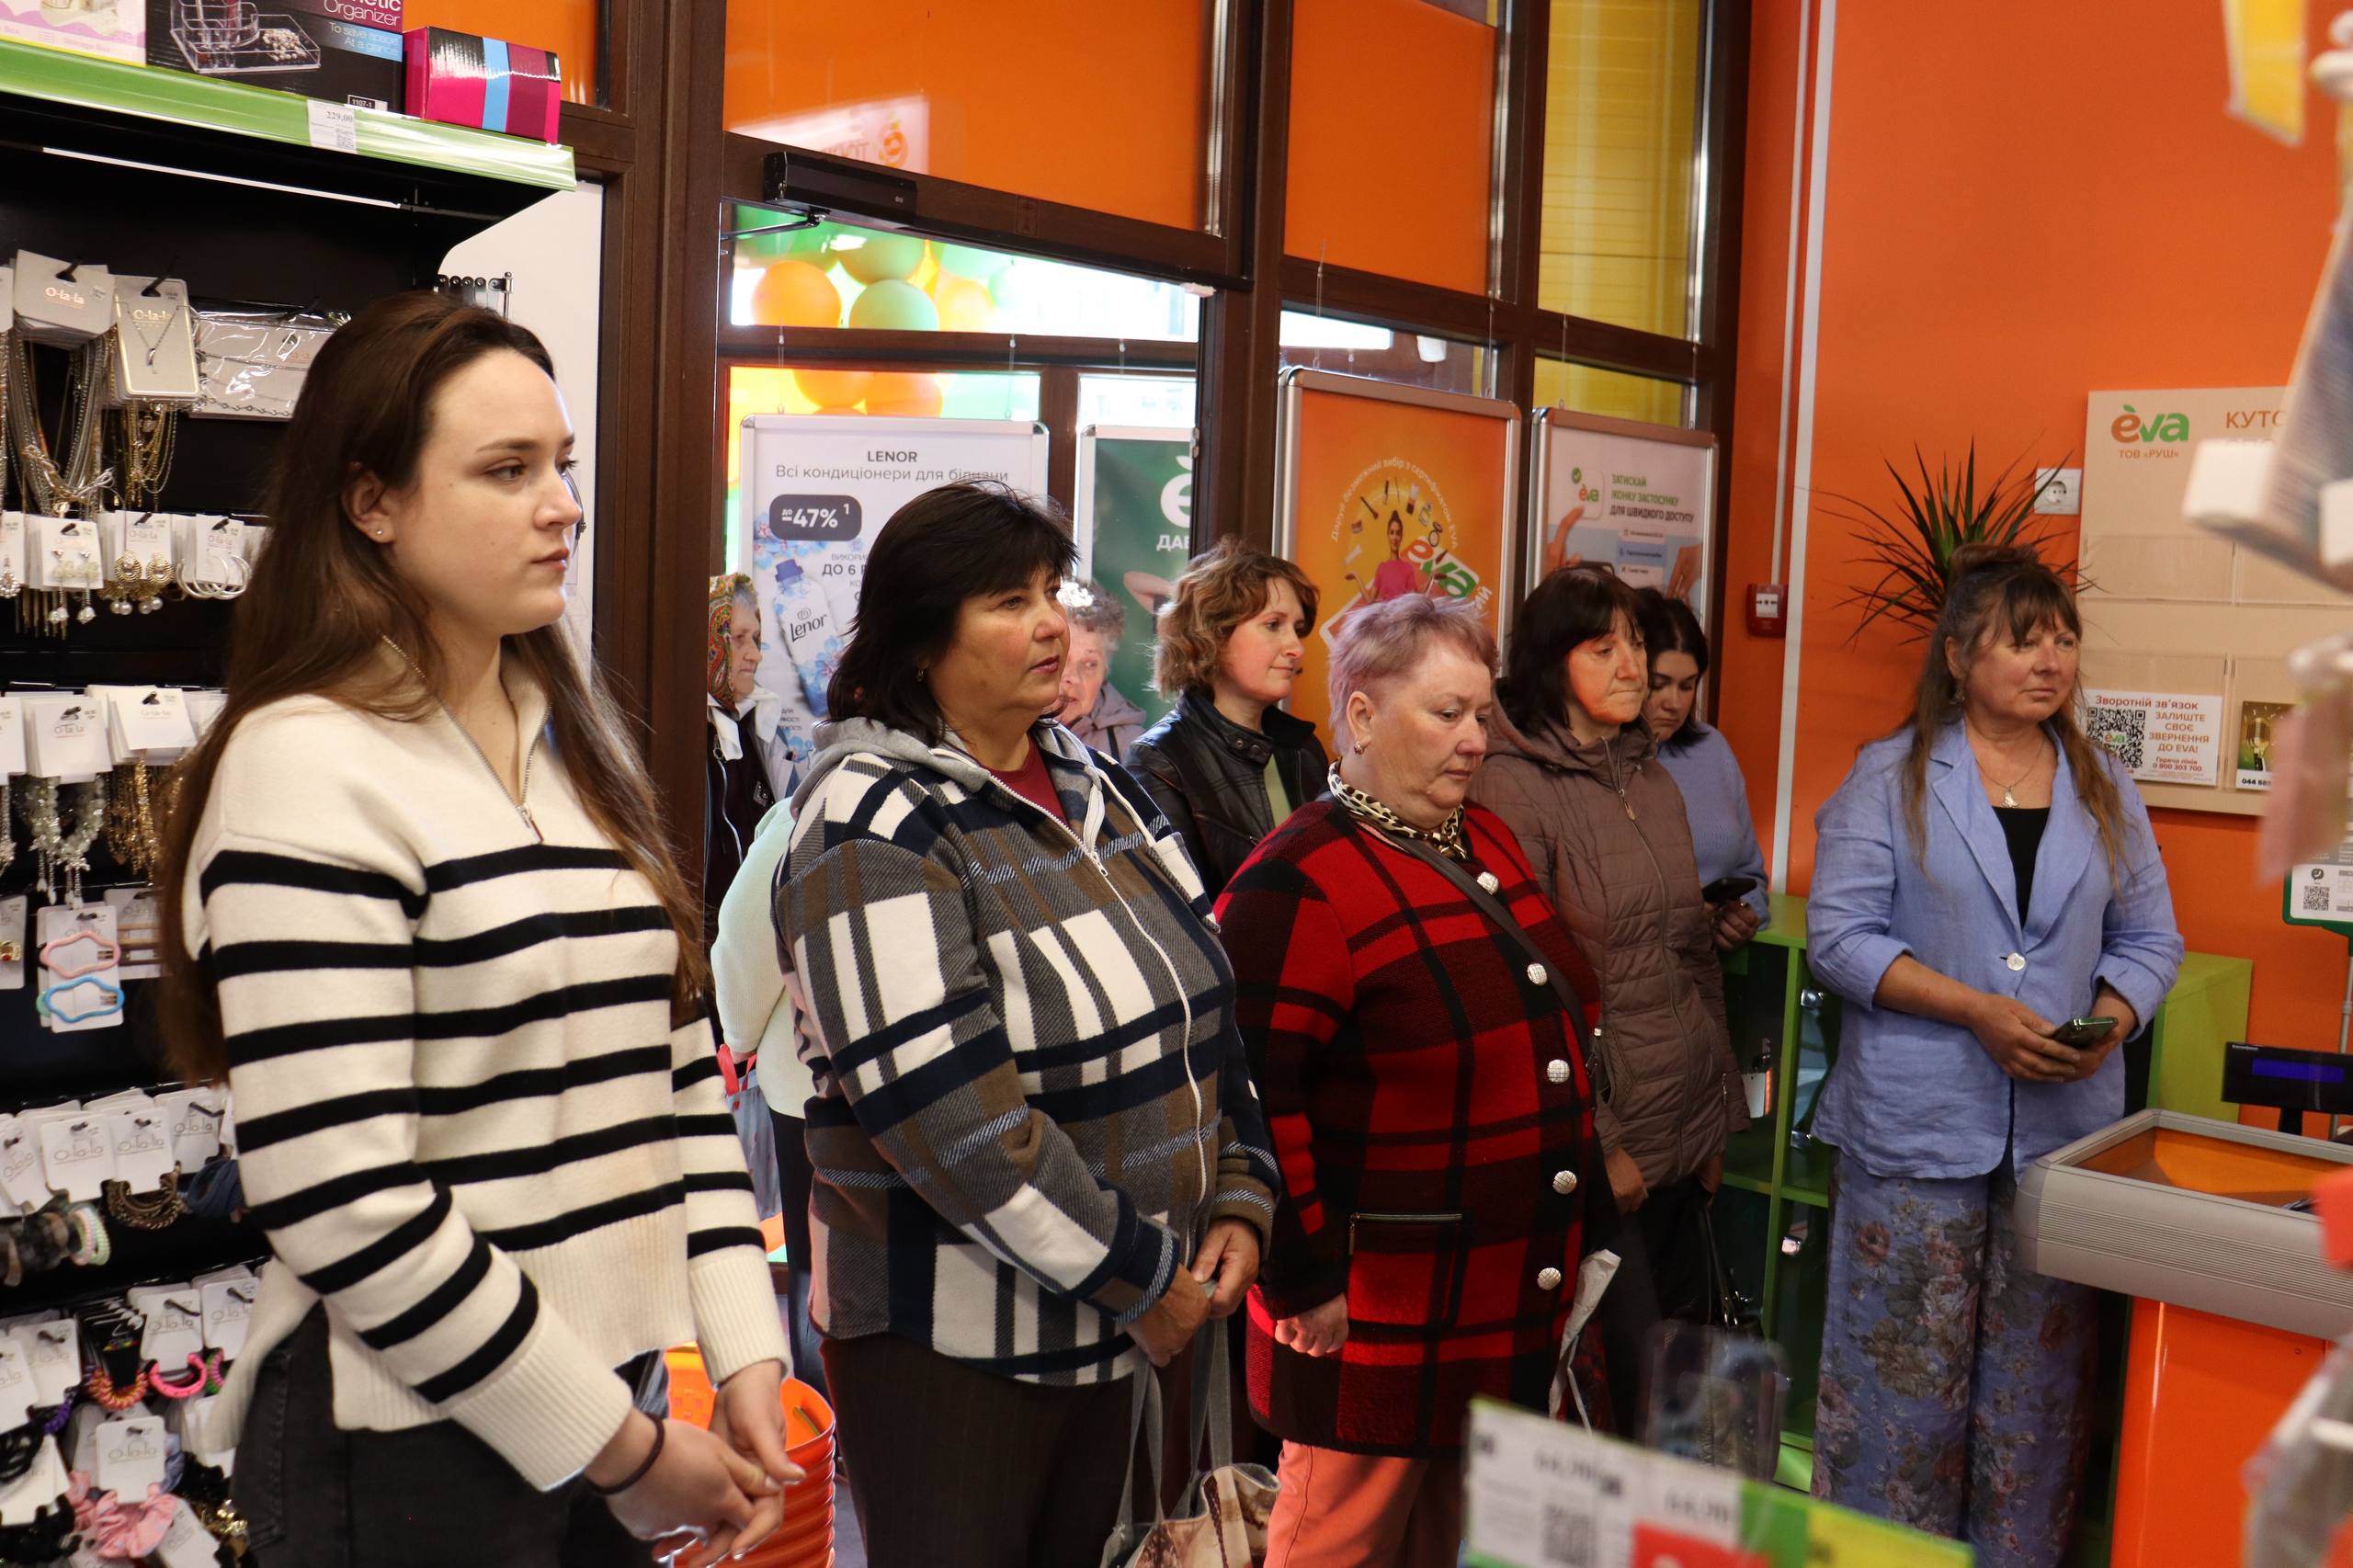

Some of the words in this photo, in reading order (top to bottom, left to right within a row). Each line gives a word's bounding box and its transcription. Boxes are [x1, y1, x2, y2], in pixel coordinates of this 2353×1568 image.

[324, 0, 401, 26] Organizer
[329, 22, 342, 33] To
[352, 98, 372, 108] 1107-1
[325, 111, 353, 122] 229,00
[45, 287, 85, 304] O-la-la
[2226, 411, 2287, 429] КУТО
[868, 450, 917, 463] LENOR
[2119, 449, 2141, 459] ТОВ
[2143, 449, 2179, 459] «РУШ»
[776, 465, 799, 478] Всі
[803, 466, 911, 482] кондиціонери
[915, 469, 943, 482] для
[1612, 474, 1646, 487] ЗАТИСКАЙ
[1610, 506, 1625, 516] ДЛЯ
[1627, 507, 1664, 519] ШВИДКОГО
[1665, 511, 1694, 523] ДОСТУПУ
[822, 563, 844, 576] ДО
[848, 564, 857, 575] 6
[790, 614, 828, 642] Lenor
[2096, 695, 2152, 707] Зворотній
[2154, 699, 2199, 710] зв'язок
[2154, 711, 2206, 722] ЗАЛИШТЕ
[2165, 722, 2194, 732] СВОЄ
[2149, 733, 2210, 744] ЗВЕРНЕННЯ
[2176, 744, 2199, 754] EVA!
